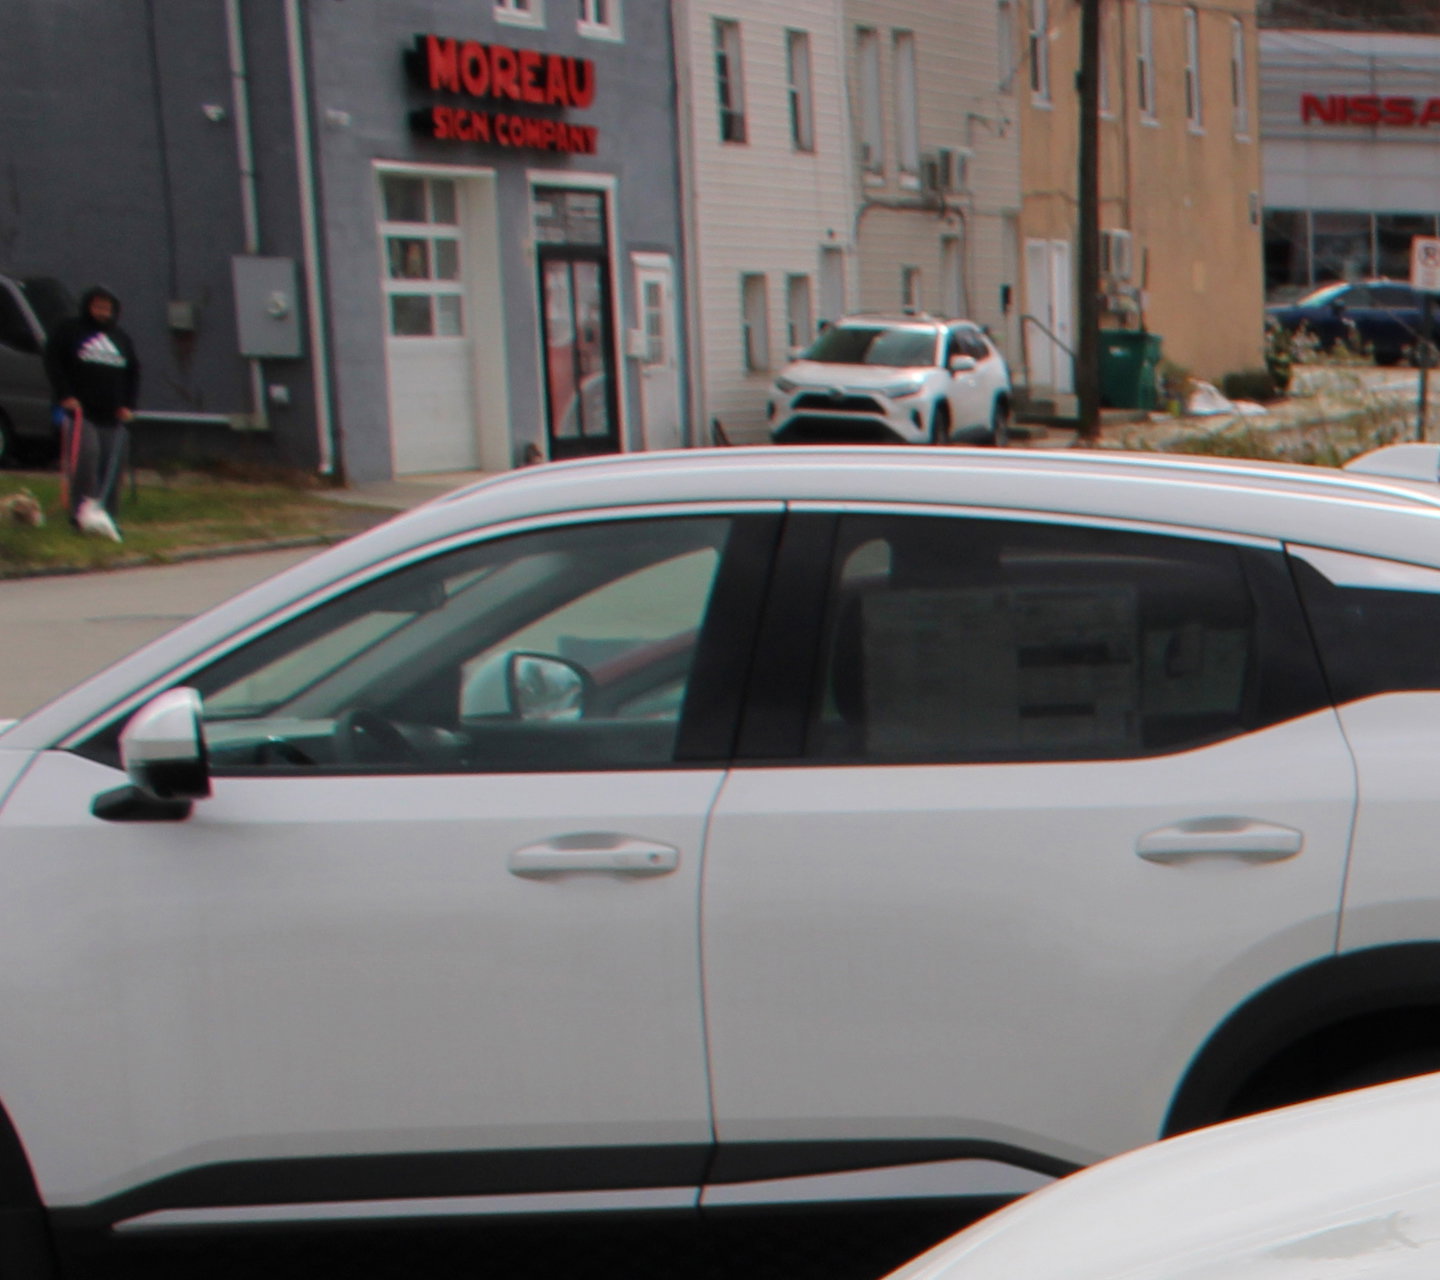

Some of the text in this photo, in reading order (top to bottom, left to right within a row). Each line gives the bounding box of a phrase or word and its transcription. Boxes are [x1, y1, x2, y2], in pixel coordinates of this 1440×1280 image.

[426, 33, 595, 110] MOREAU
[432, 106, 598, 156] SIGN COMPANY
